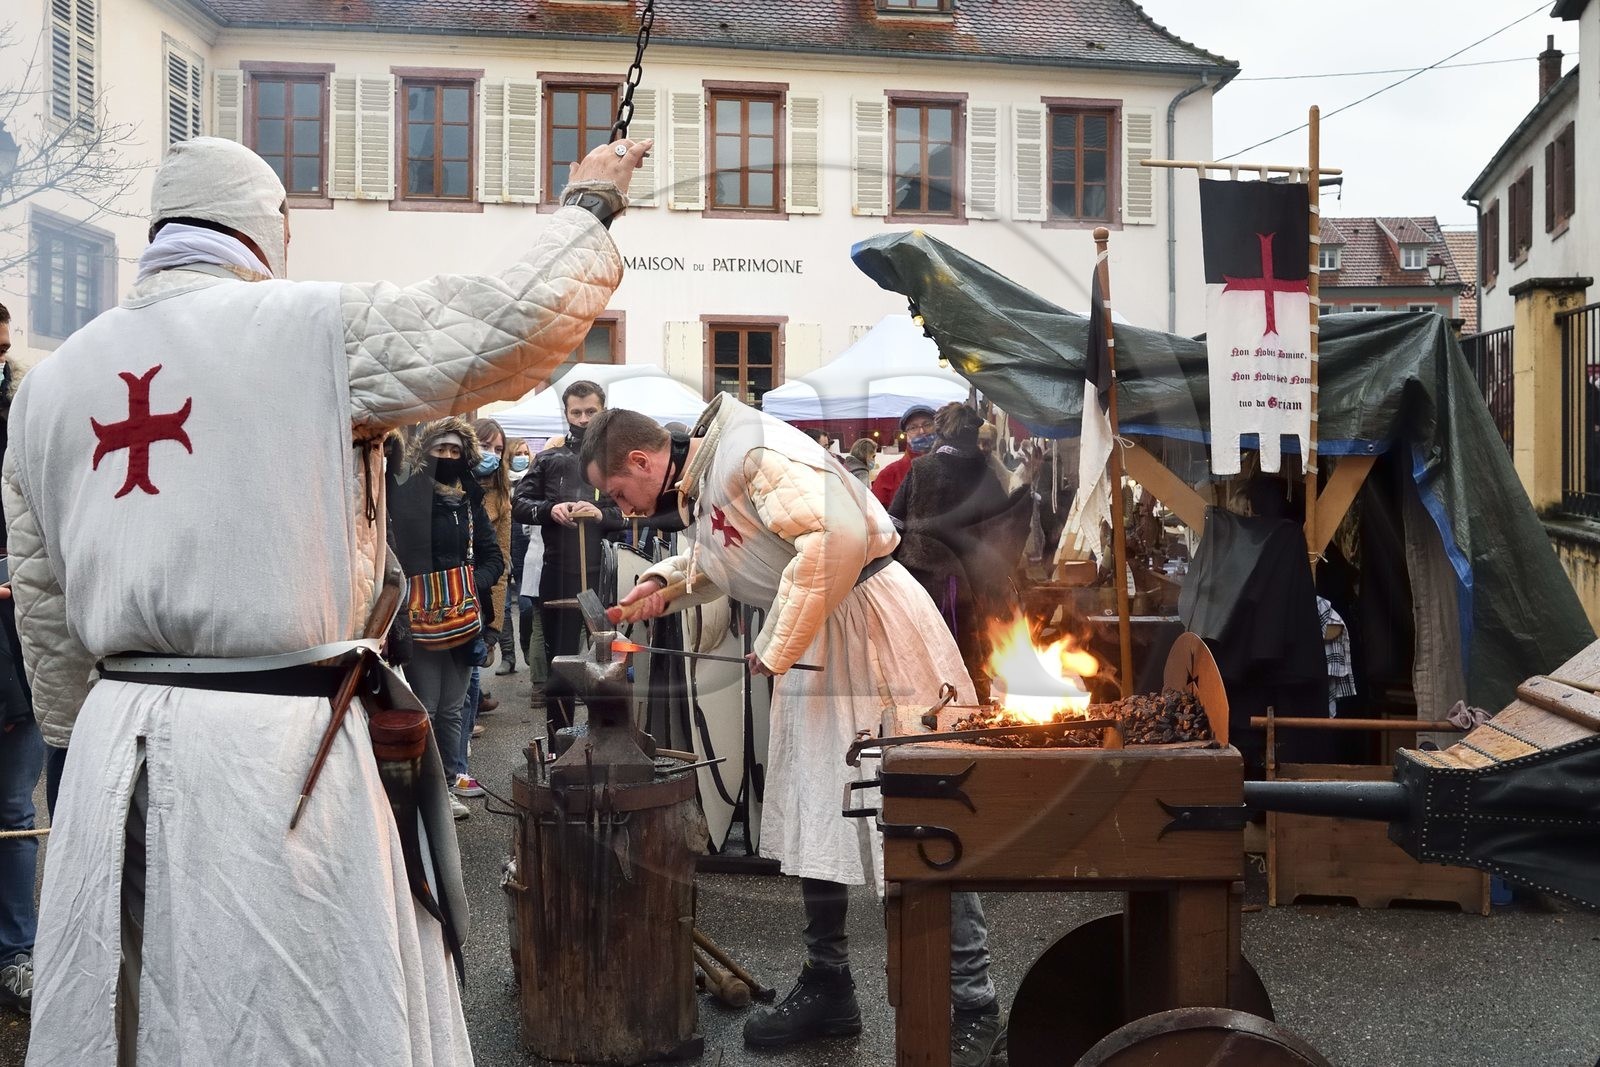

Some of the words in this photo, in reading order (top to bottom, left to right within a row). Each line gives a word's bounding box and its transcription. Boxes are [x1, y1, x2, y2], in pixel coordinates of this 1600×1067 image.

[623, 255, 685, 271] MAISON
[693, 263, 705, 272] DU
[712, 258, 804, 274] PATRIMOINE
[1231, 347, 1250, 357] Non
[1231, 371, 1250, 382] Non
[1239, 399, 1253, 408] tuo
[1256, 399, 1266, 408] da
